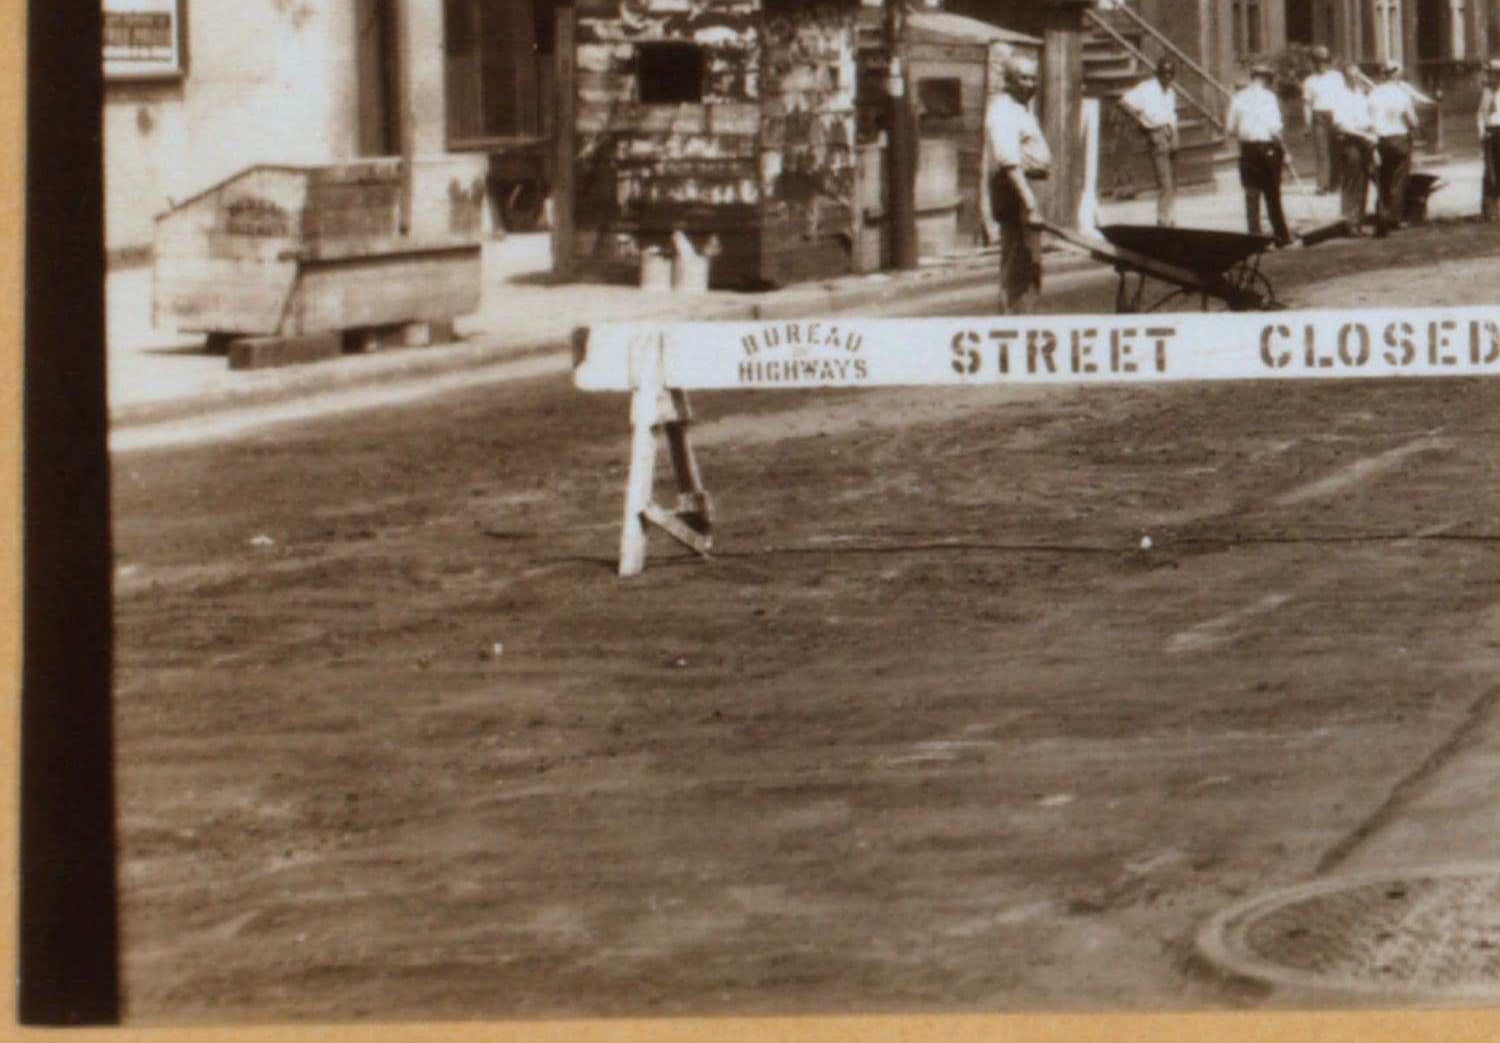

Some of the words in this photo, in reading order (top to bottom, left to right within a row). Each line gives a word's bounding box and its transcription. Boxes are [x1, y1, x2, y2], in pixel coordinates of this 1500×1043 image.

[741, 322, 864, 355] BUREAU
[950, 327, 1177, 375] STREET
[738, 359, 868, 383] HIGHWAYS
